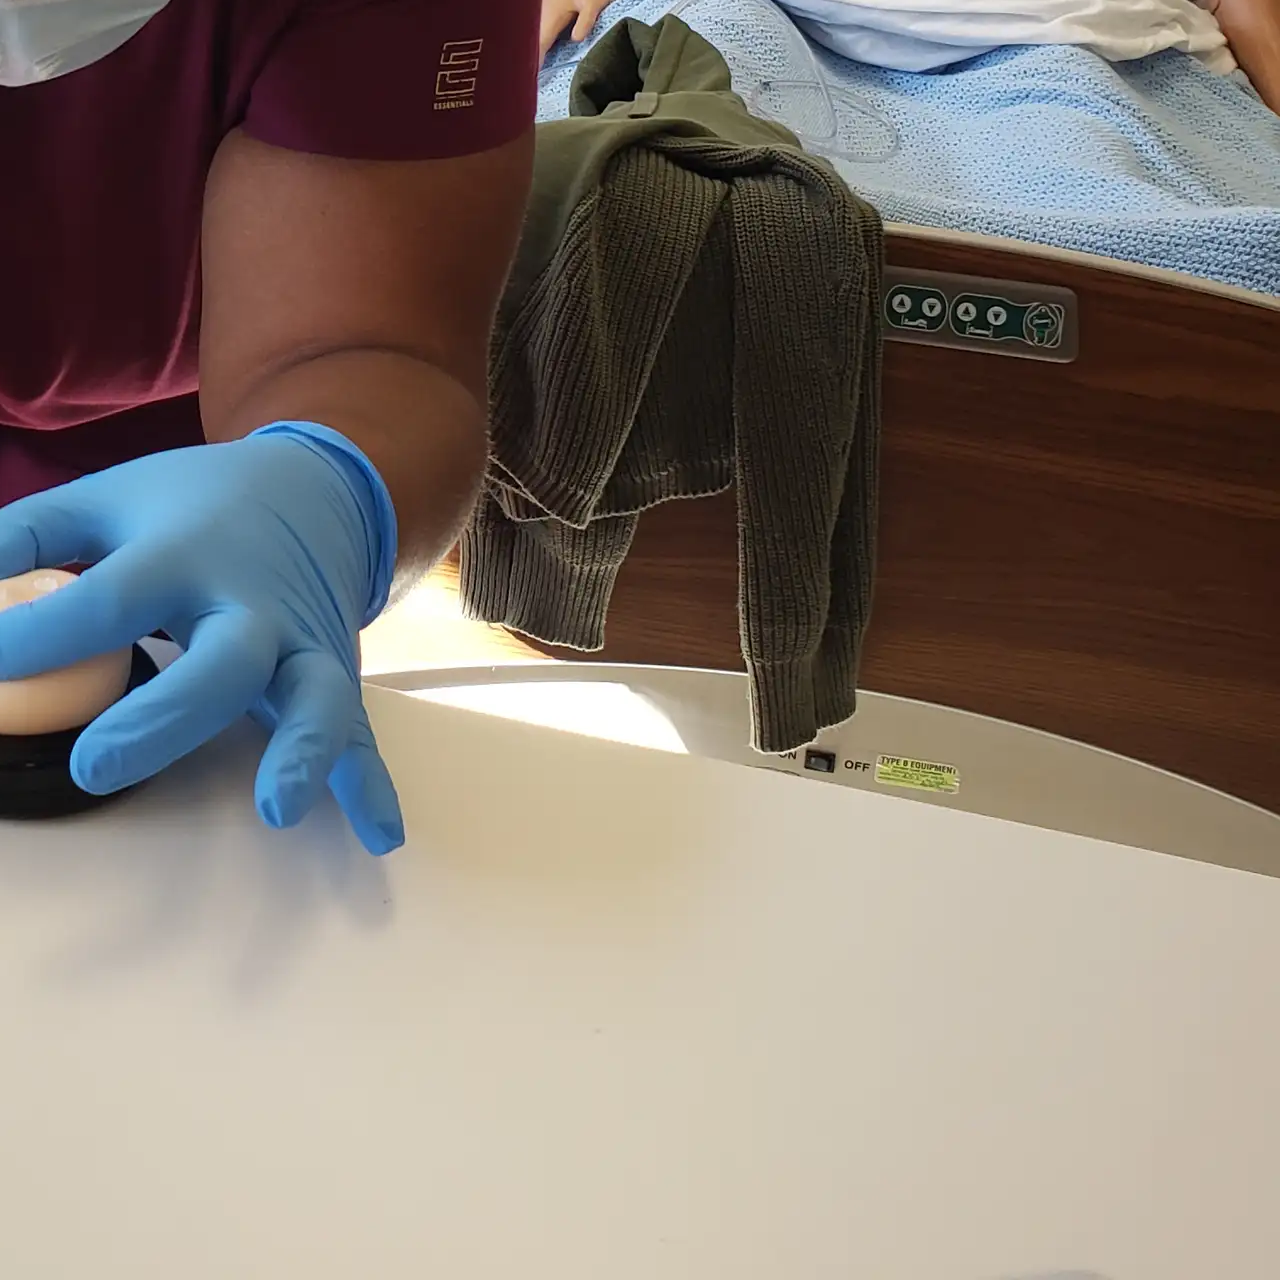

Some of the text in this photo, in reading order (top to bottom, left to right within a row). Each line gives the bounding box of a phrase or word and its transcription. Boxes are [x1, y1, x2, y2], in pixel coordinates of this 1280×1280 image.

[433, 99, 475, 111] ESSENTIALS
[844, 759, 871, 773] OFF
[880, 756, 901, 766] TYPE
